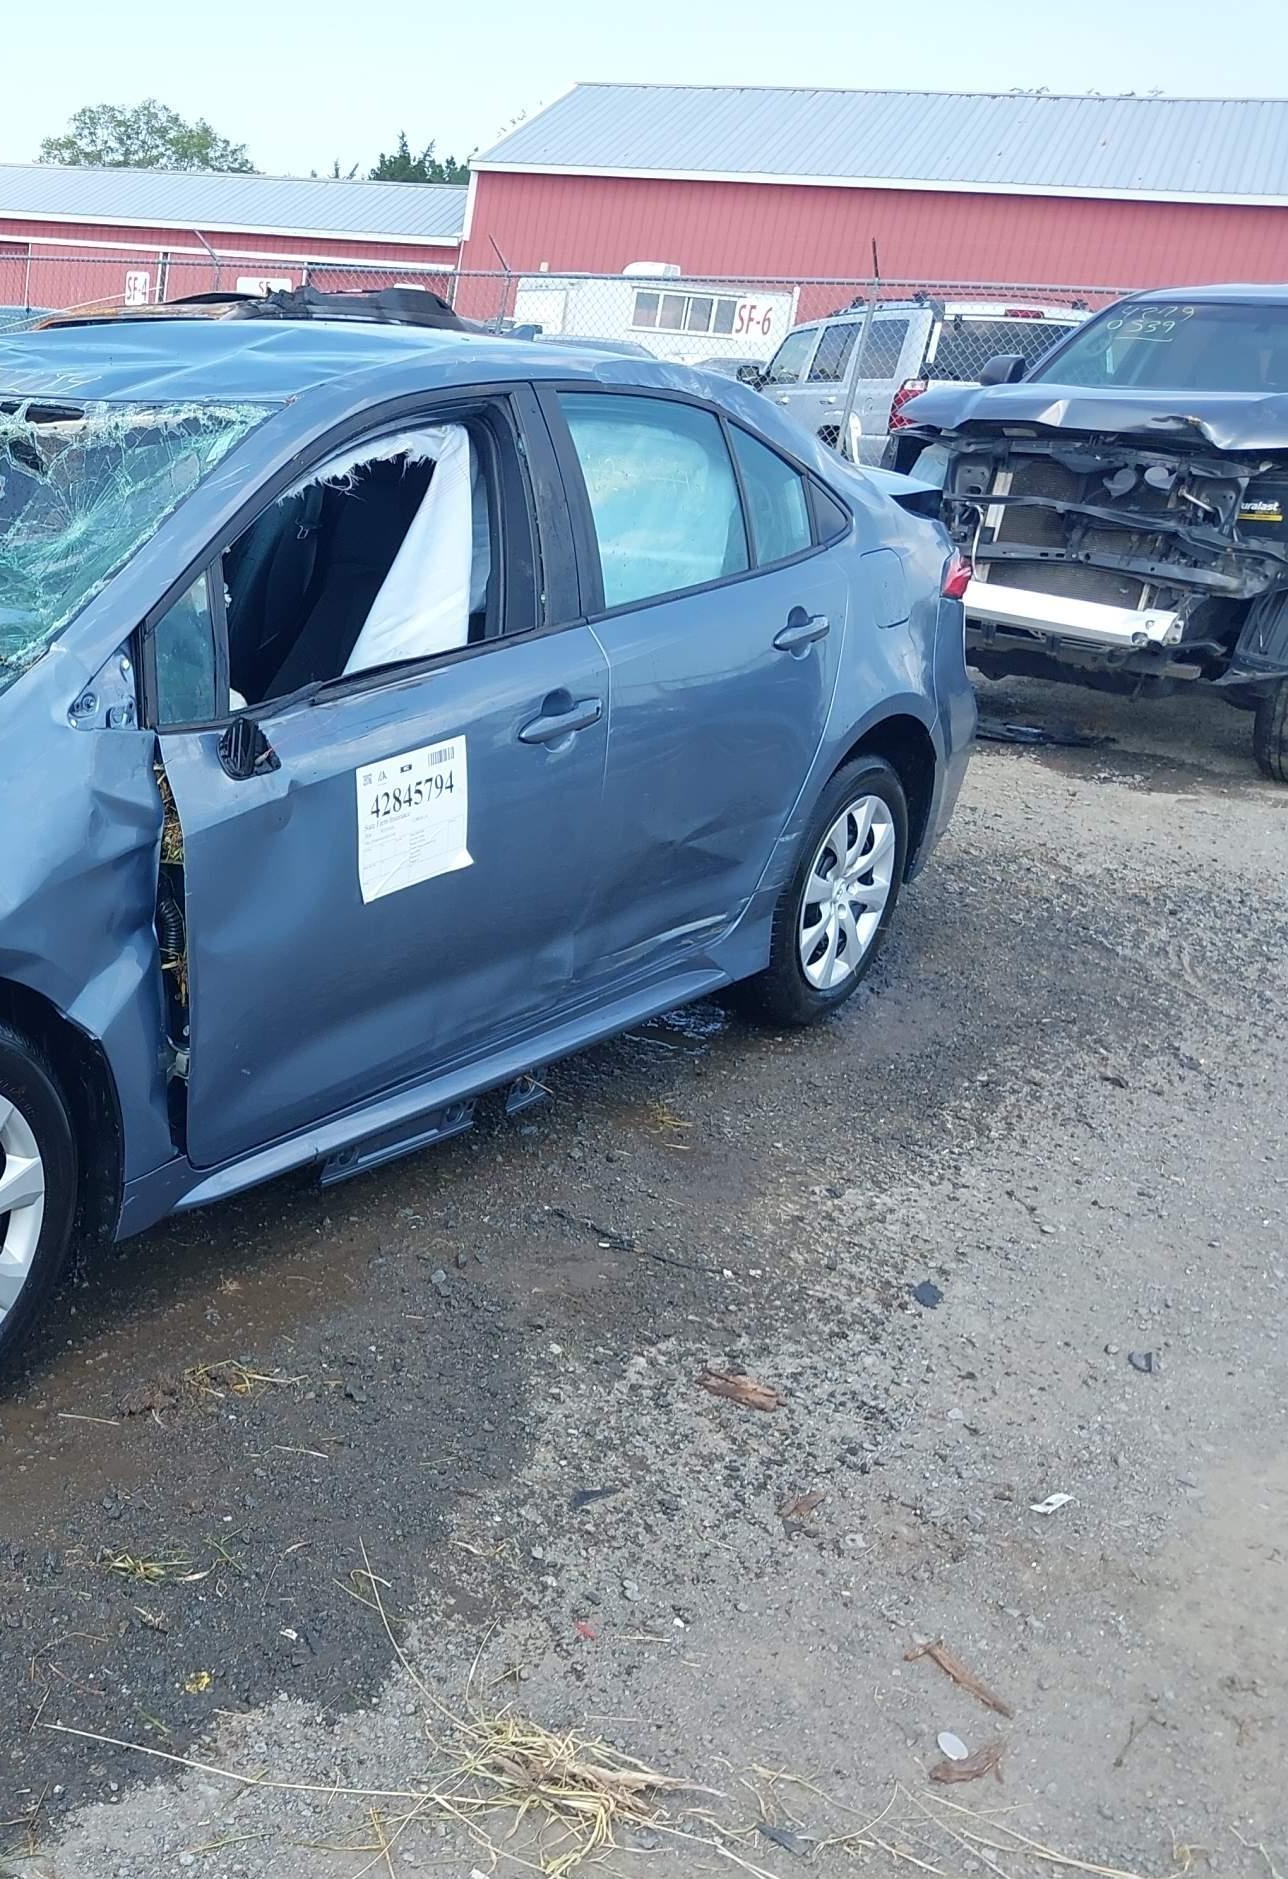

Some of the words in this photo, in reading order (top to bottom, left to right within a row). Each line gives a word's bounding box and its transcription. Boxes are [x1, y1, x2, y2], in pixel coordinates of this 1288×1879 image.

[126, 276, 147, 301] SF-4
[735, 304, 773, 335] SF-6
[1240, 501, 1280, 511] uralast
[370, 769, 454, 818] 42845794
